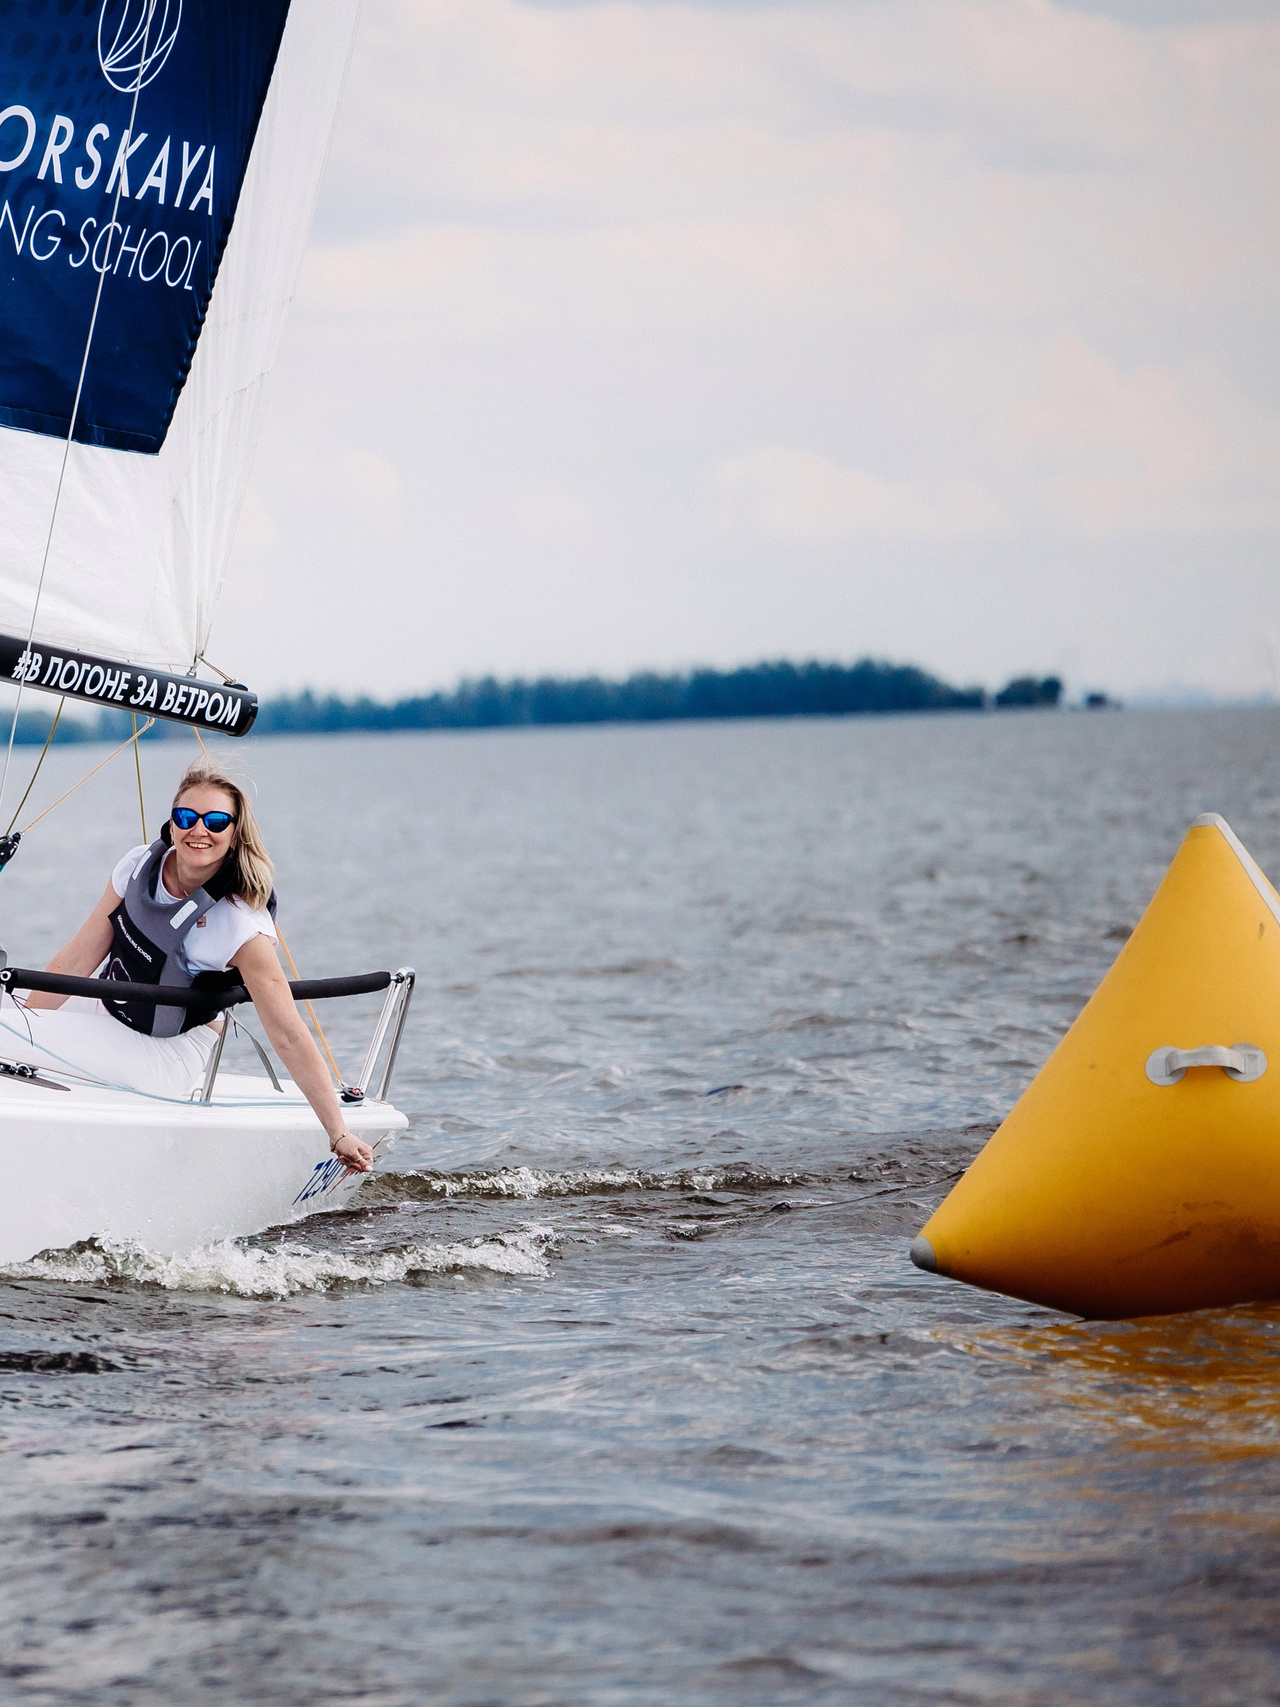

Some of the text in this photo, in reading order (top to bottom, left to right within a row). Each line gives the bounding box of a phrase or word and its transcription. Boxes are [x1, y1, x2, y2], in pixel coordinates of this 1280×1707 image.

[68, 216, 202, 291] SCHOOL
[41, 657, 132, 701] ПОГОНЕ
[129, 675, 159, 709] ЗА
[159, 681, 242, 727] ВЕТРОМ
